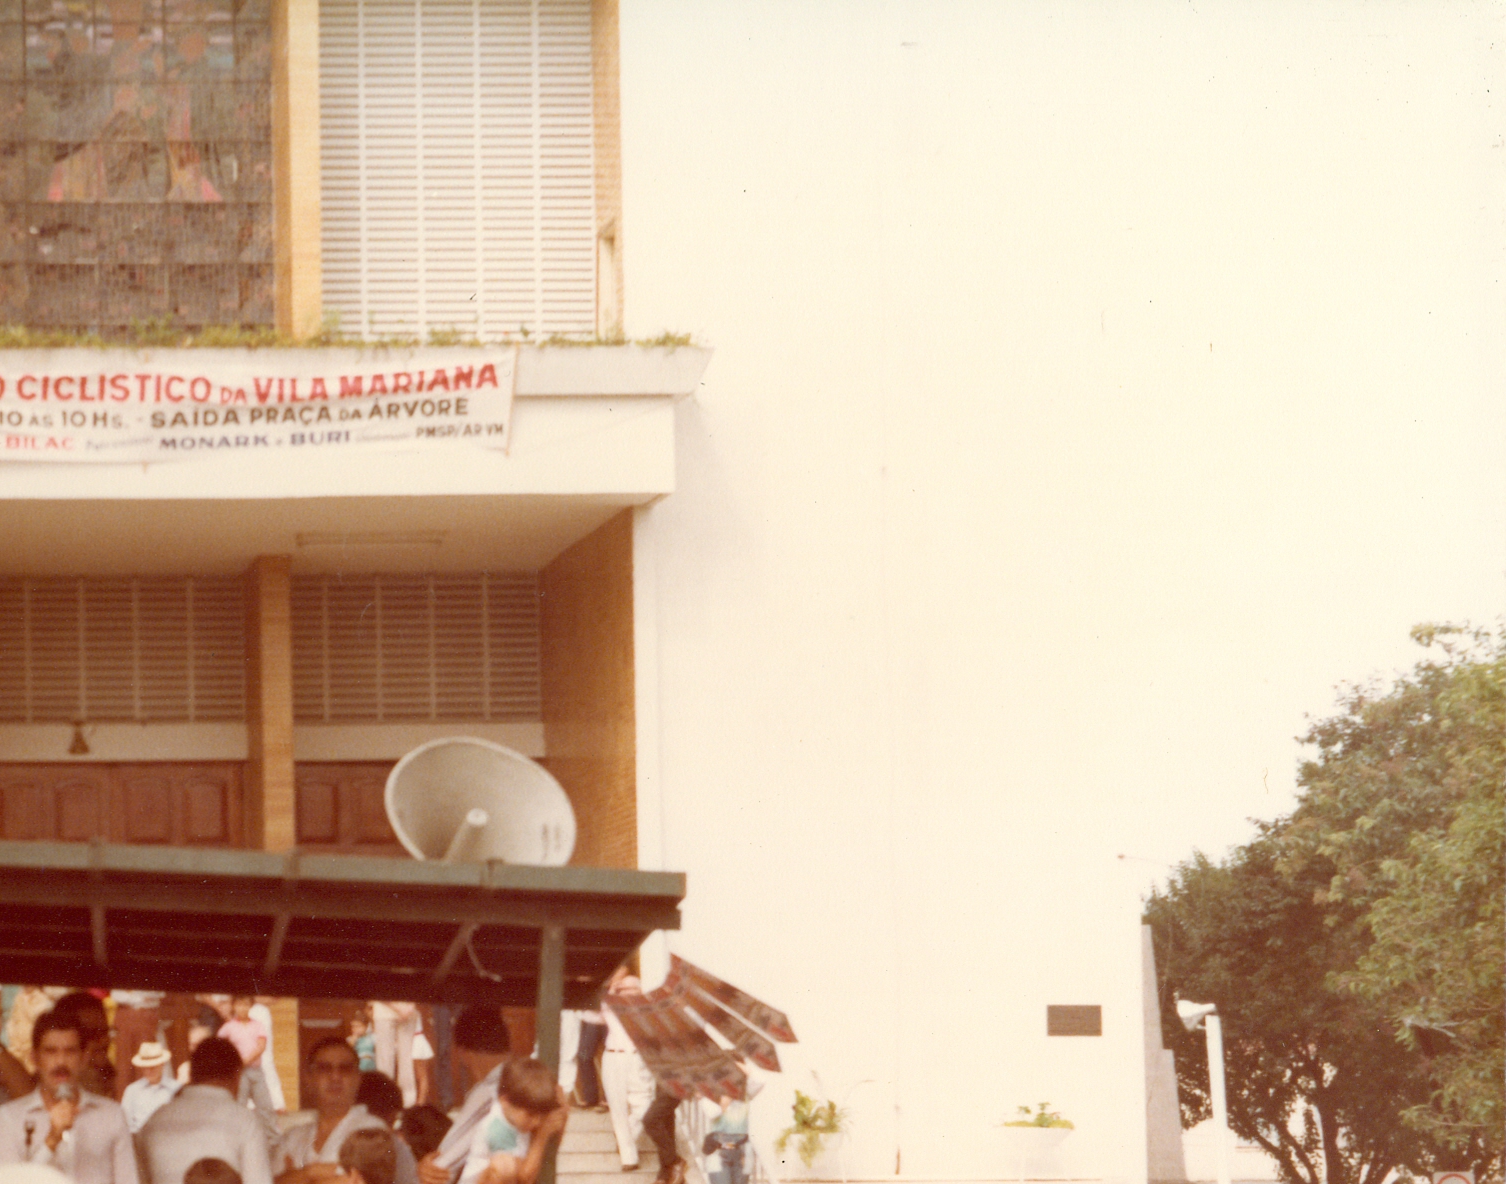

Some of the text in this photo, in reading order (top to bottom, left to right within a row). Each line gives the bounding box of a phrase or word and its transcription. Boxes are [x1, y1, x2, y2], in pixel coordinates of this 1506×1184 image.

[17, 374, 212, 403] CICLISTICO
[220, 386, 247, 405] DA
[253, 377, 328, 404] VILA
[338, 363, 499, 399] MARIANA
[250, 405, 331, 425] PRAÇA
[339, 408, 362, 421] DA
[6, 434, 73, 450] BILAC
[159, 434, 269, 450] MONARK
[290, 430, 350, 446] BURI
